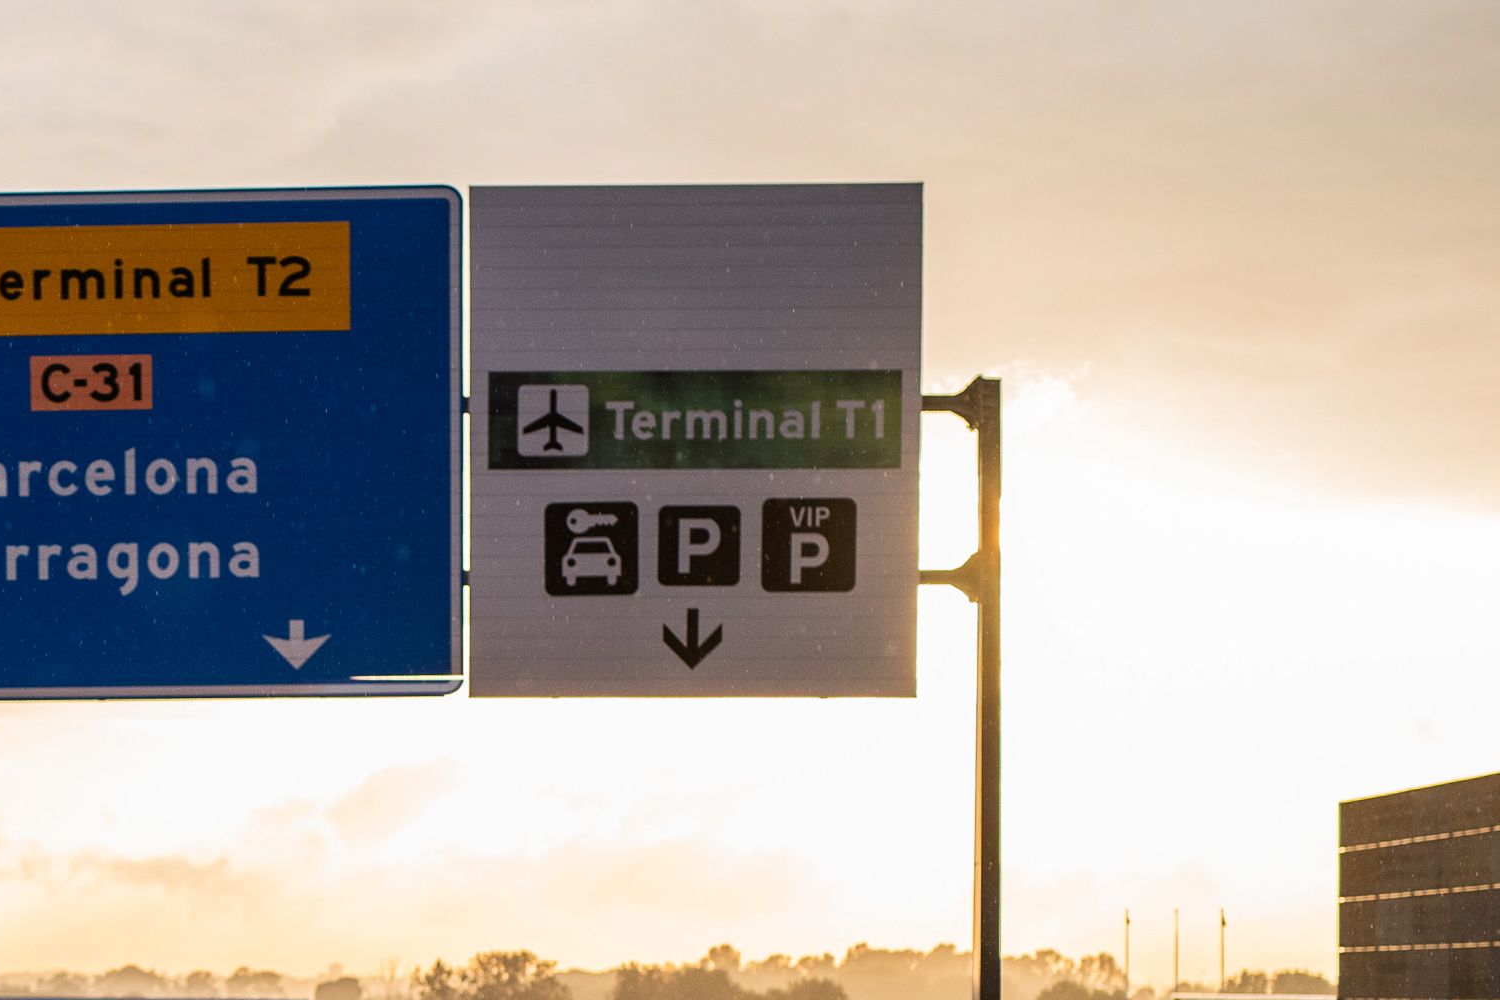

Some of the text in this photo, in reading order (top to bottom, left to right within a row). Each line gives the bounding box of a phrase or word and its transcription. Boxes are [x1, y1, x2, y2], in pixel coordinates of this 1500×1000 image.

[246, 256, 312, 297] T2
[41, 362, 143, 404] C-31
[605, 398, 886, 440] Terminal T1
[789, 507, 831, 527] VIP
[677, 519, 721, 573] P
[790, 533, 830, 583] P
